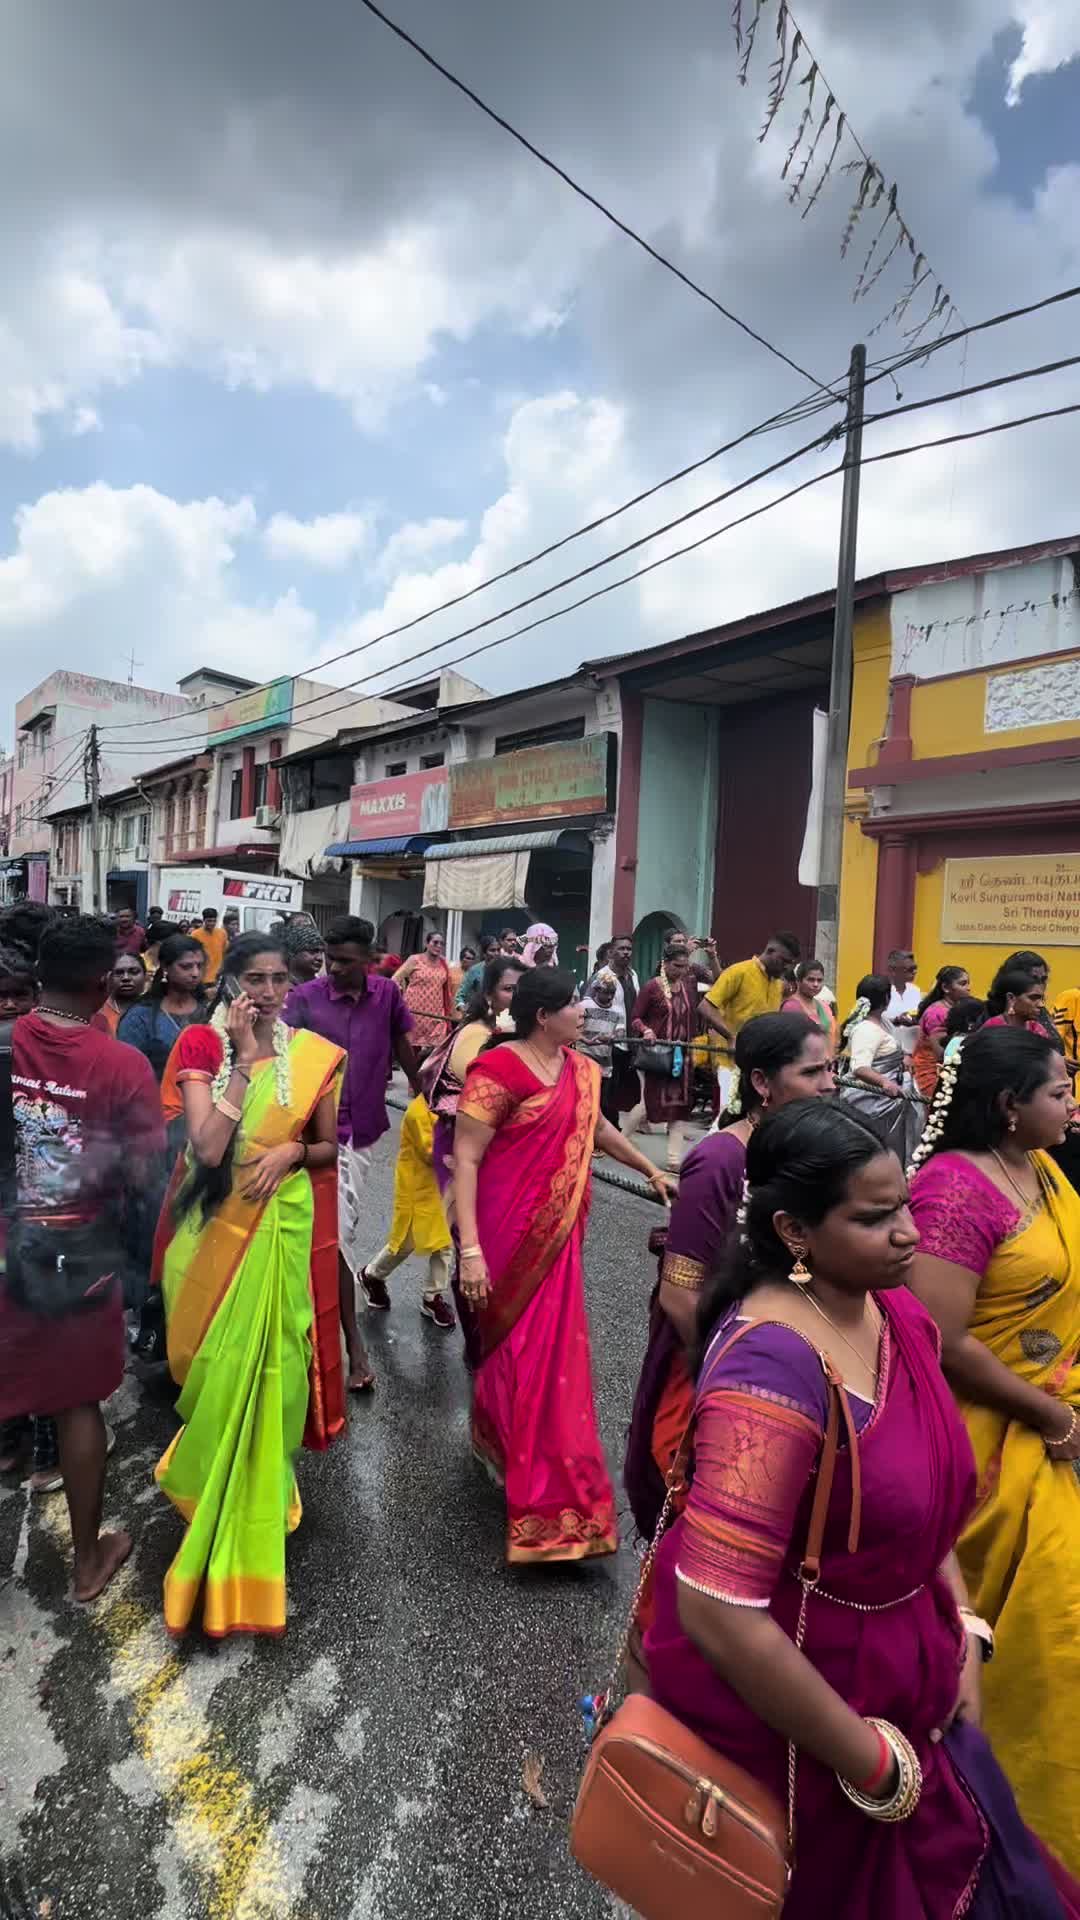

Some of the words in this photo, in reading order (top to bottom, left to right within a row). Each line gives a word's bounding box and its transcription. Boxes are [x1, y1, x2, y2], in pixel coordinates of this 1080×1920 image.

[360, 791, 407, 817] MAXXIS
[950, 892, 977, 904] Kovil
[1003, 907, 1018, 918] Sri
[1022, 907, 1080, 920] Thendayu
